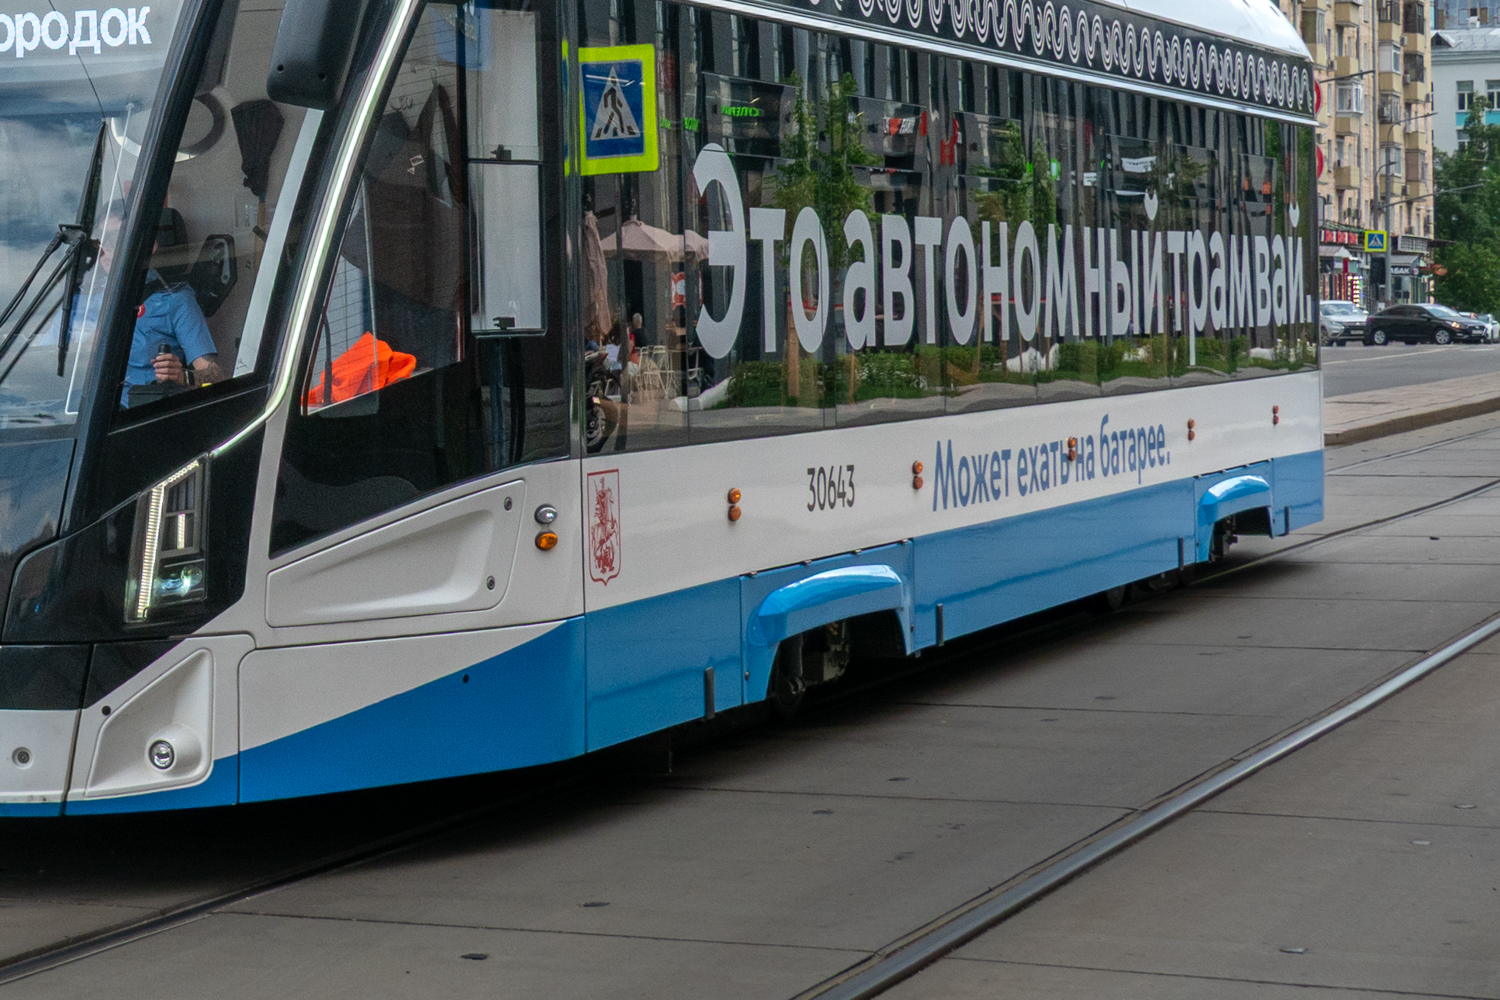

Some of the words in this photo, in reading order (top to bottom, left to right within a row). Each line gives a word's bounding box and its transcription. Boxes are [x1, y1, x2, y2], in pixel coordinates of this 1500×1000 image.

[693, 142, 829, 359] Это
[843, 188, 1164, 350] автономный
[1167, 201, 1313, 366] трамвай.
[806, 464, 855, 512] 30643
[932, 439, 1011, 512] Может
[1017, 440, 1071, 497] ехать
[1076, 434, 1095, 484] на
[1099, 413, 1171, 485] батарее.
